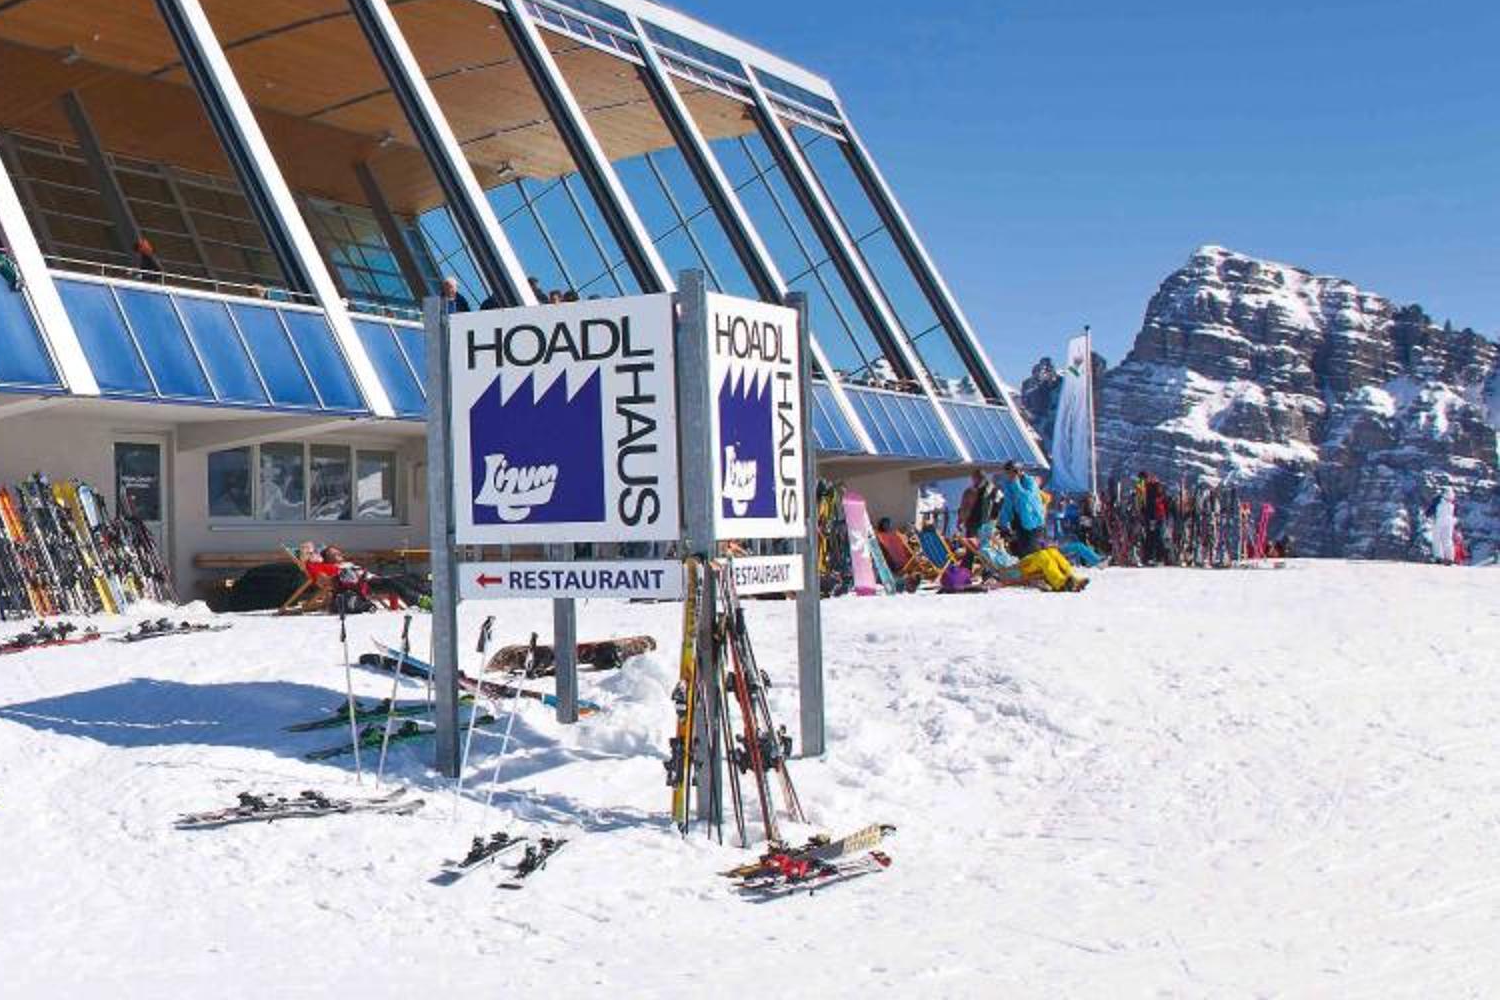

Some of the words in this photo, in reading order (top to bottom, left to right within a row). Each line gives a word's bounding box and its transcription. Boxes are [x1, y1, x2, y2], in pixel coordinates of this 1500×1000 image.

[467, 315, 654, 370] HOADL
[715, 312, 792, 365] HOADL
[615, 363, 661, 526] HAUS
[776, 371, 798, 525] HAUS
[509, 569, 664, 590] RESTAURANT
[734, 564, 790, 585] ESTAURANT
